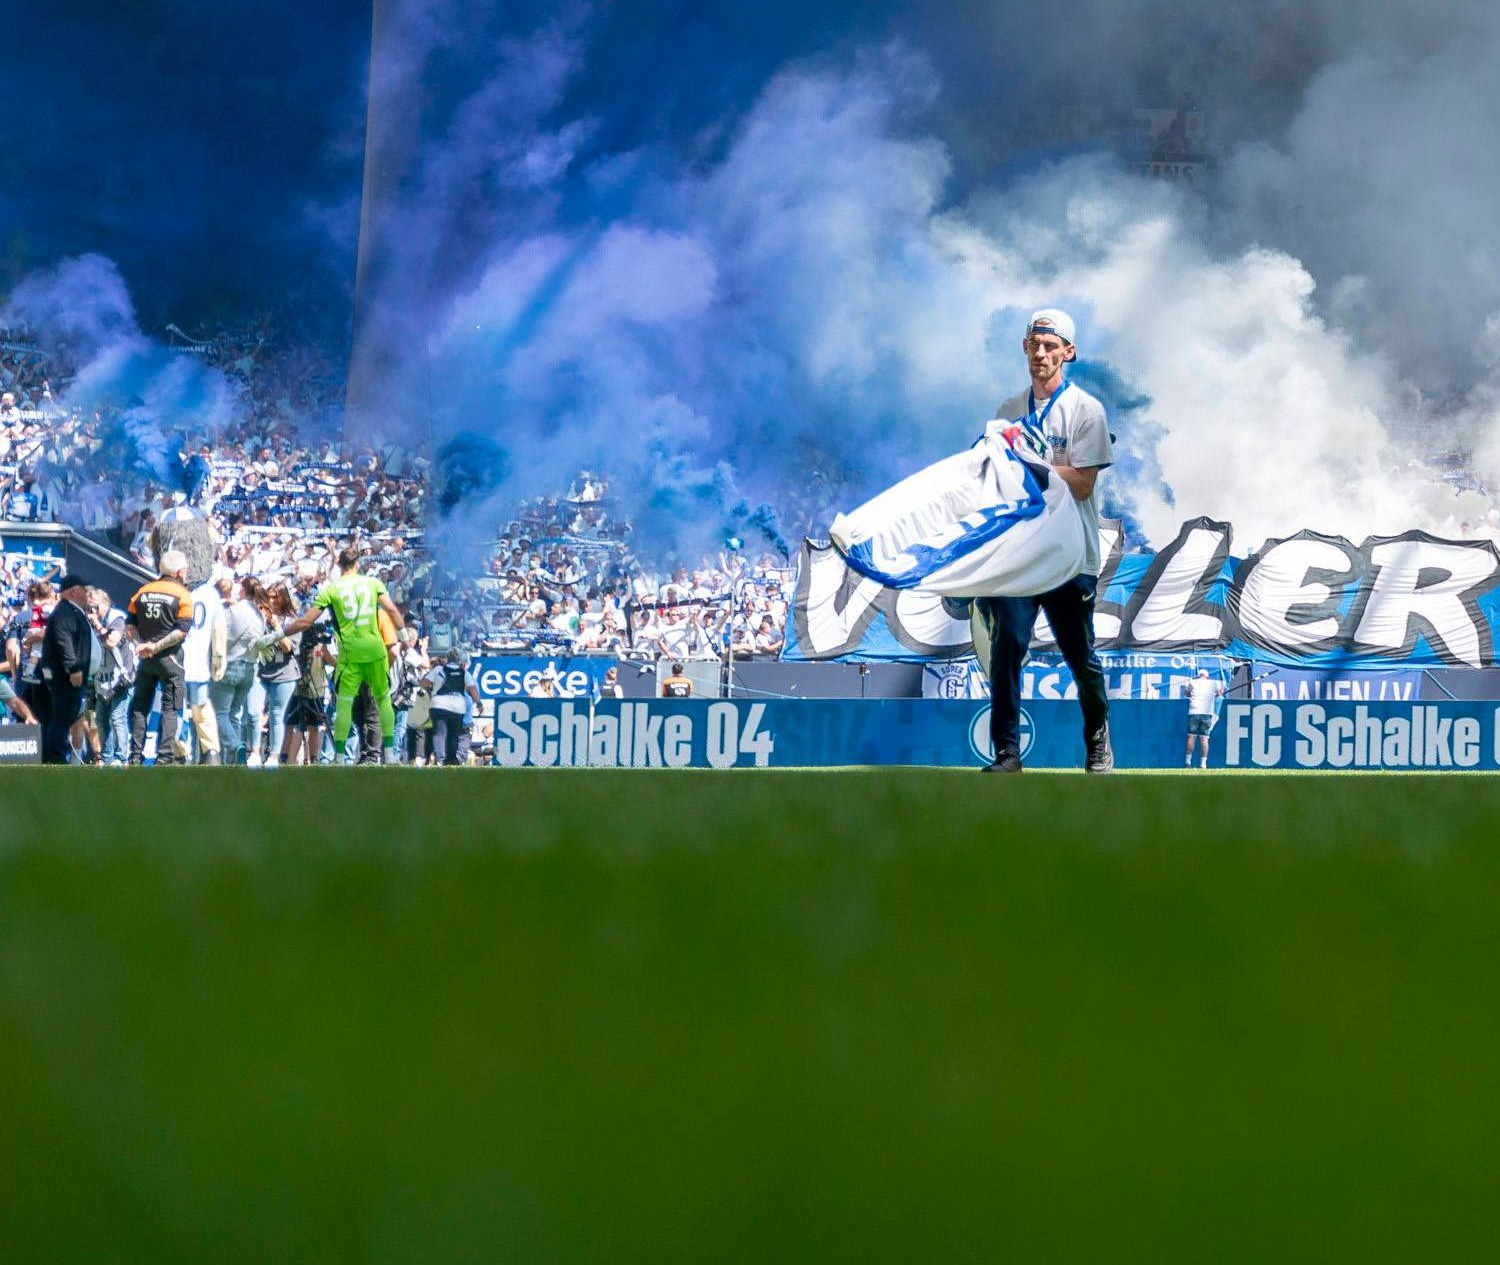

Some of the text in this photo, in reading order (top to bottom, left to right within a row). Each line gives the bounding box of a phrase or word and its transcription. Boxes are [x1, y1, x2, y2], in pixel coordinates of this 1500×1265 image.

[145, 603, 161, 618] 35
[340, 585, 374, 618] 32
[1099, 655, 1157, 669] halke
[496, 701, 774, 767] Schalke 04
[1226, 704, 1282, 766] FC
[1295, 704, 1480, 767] Schalke
